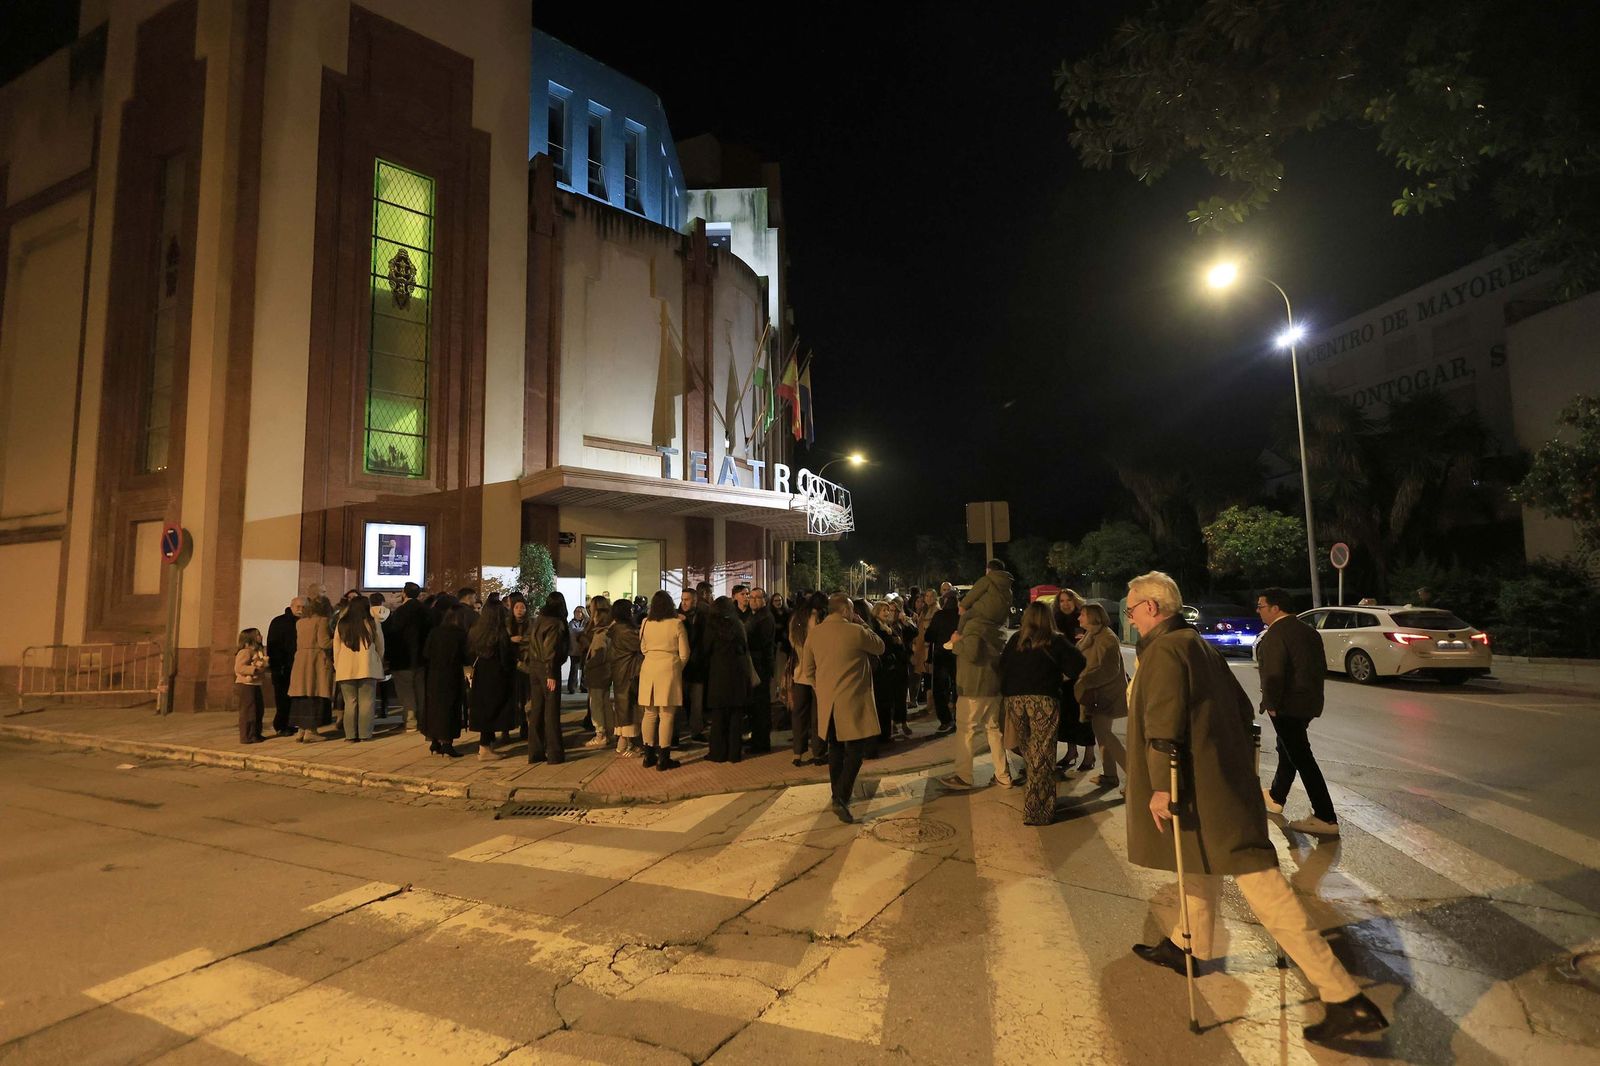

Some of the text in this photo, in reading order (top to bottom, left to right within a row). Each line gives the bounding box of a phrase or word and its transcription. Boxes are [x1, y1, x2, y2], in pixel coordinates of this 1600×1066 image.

[1306, 323, 1374, 366] CENTRO
[1382, 309, 1408, 336] DE
[656, 446, 813, 498] TEATRO
